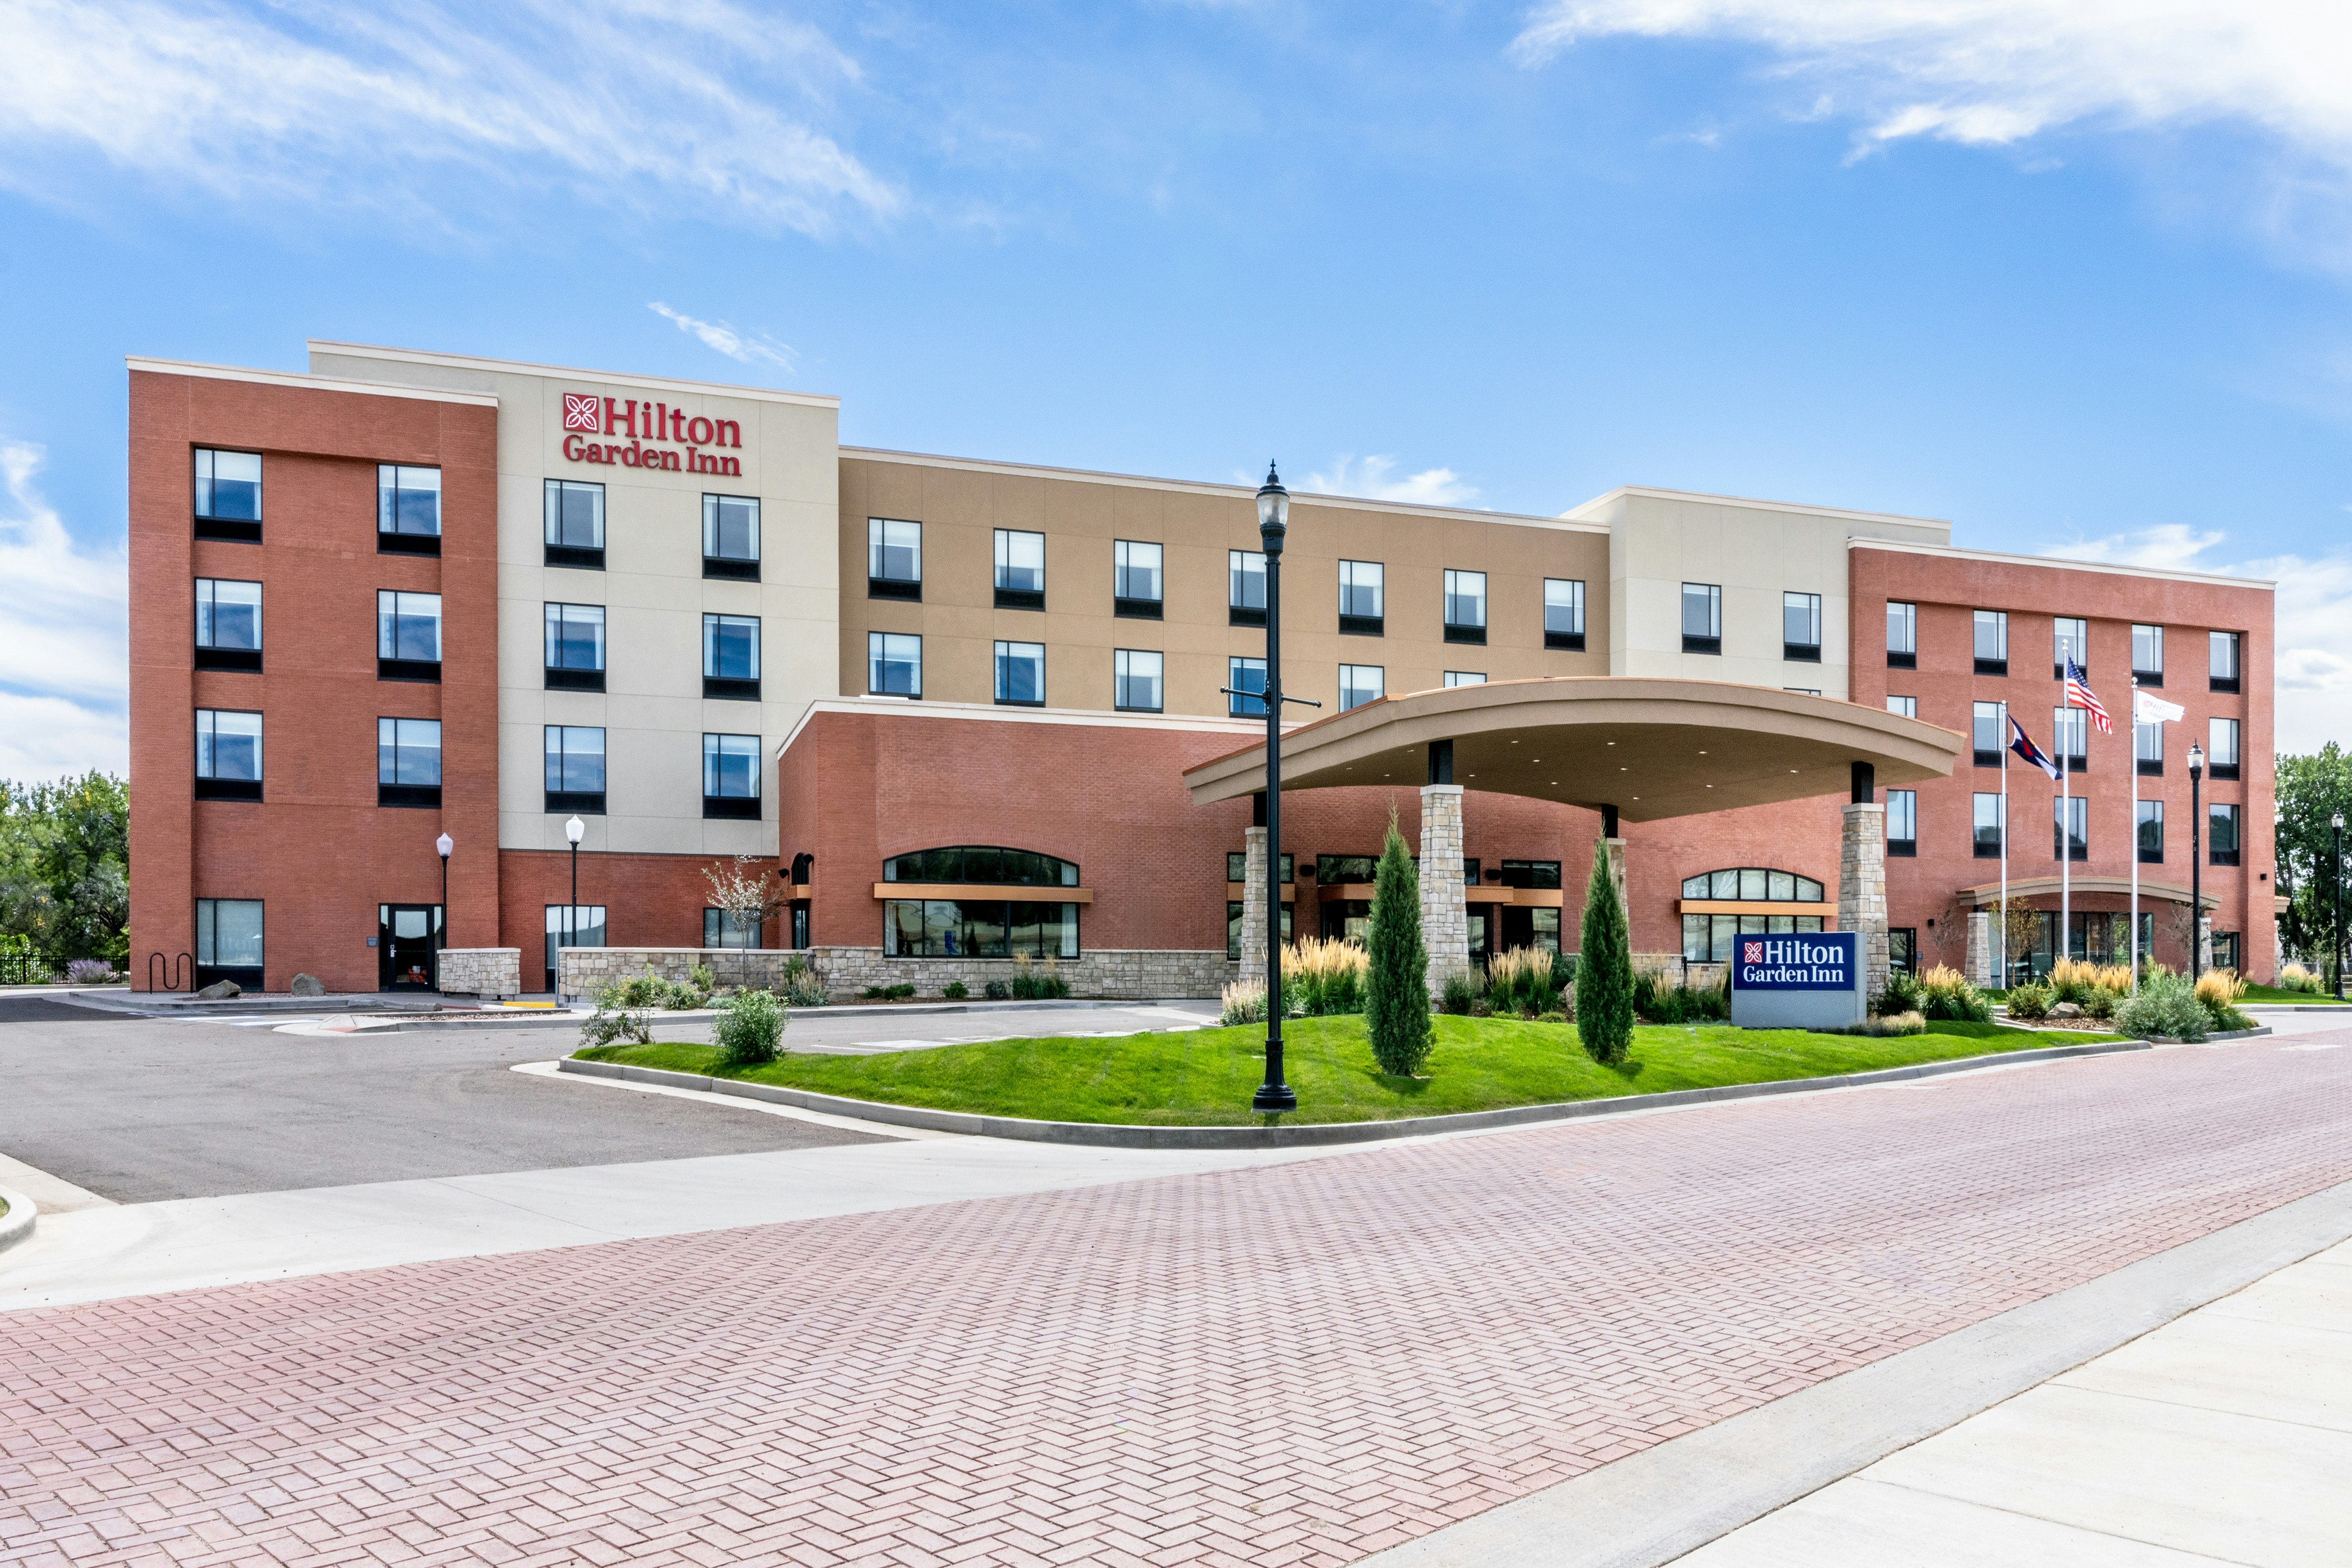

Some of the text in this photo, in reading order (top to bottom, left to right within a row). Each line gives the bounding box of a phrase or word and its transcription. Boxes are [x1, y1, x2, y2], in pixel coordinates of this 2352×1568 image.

[603, 397, 742, 448] Hilton
[563, 434, 742, 476] Garden Inn
[1765, 941, 1844, 964] Hilton
[1743, 965, 1844, 982] Garden Inn
